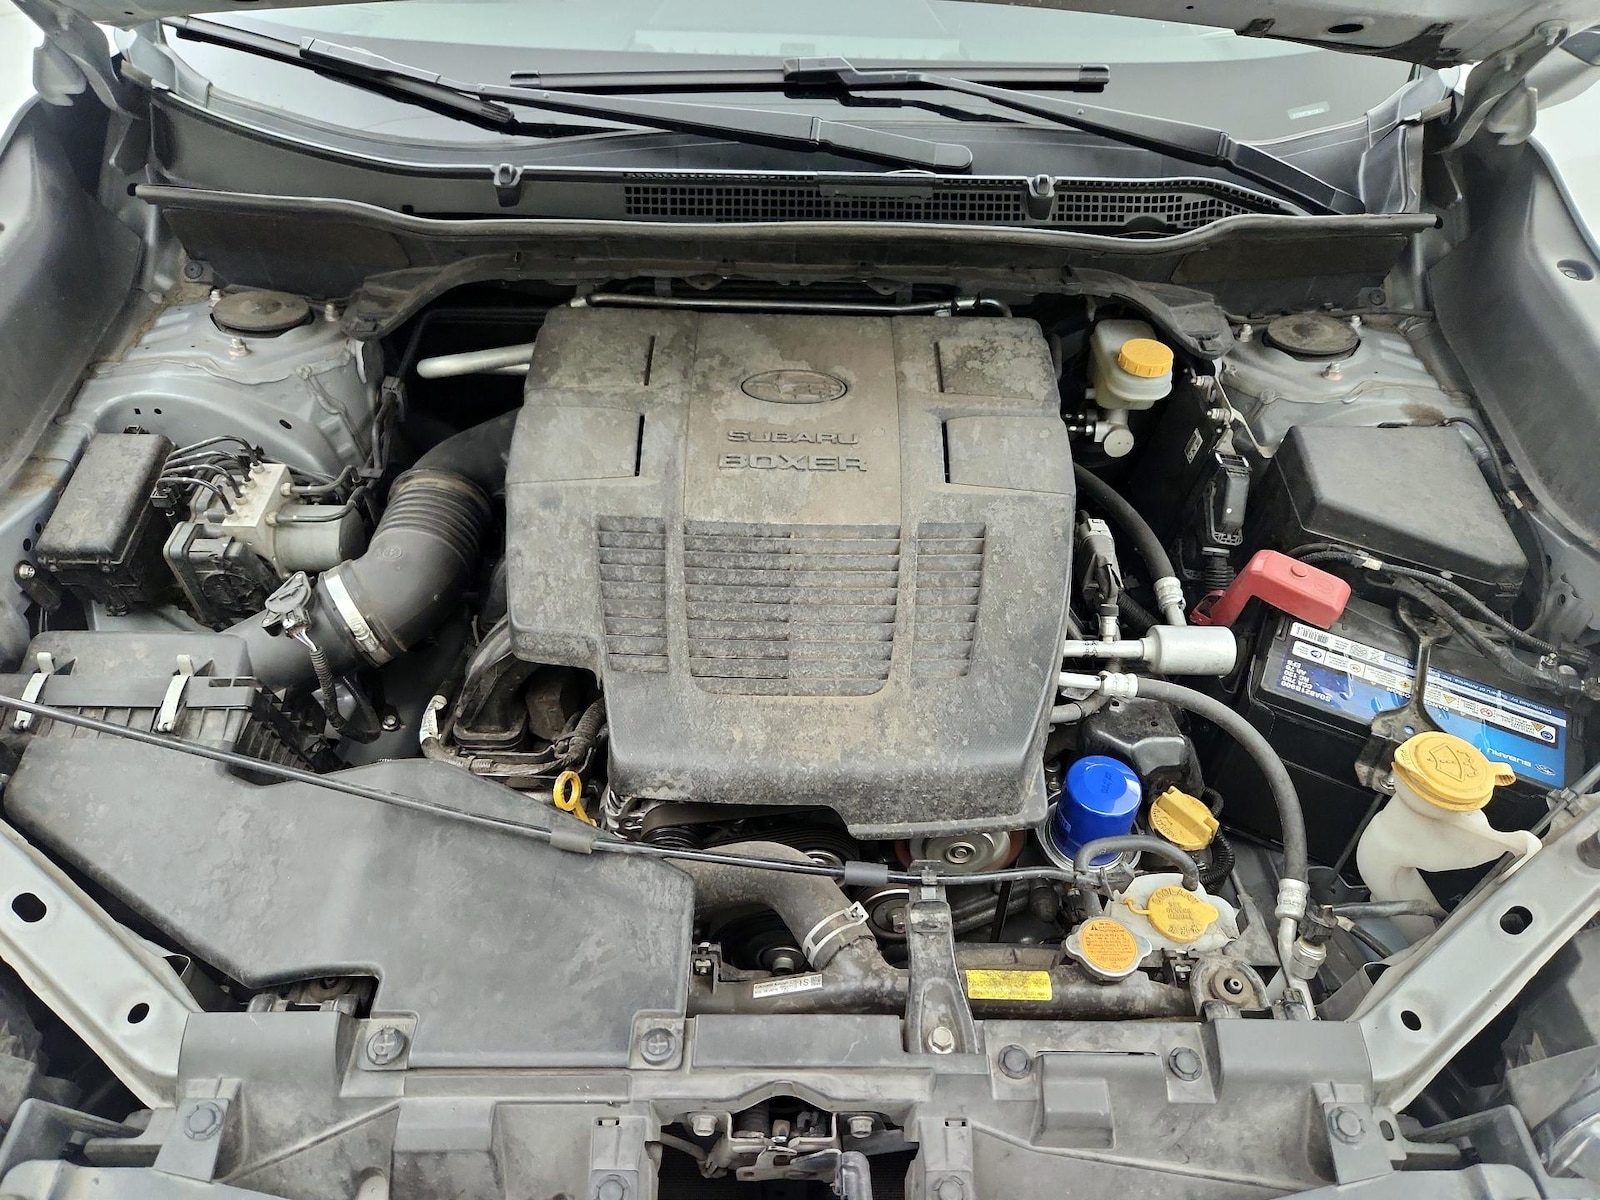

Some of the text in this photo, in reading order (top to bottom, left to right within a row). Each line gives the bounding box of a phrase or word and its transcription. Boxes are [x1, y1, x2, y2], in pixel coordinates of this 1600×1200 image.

[728, 430, 859, 444] SUBARU
[718, 453, 867, 472] BOXER
[1298, 680, 1313, 690] CCA
[1386, 687, 1411, 699] OISON
[1519, 700, 1552, 715] Distributed
[1486, 747, 1532, 767] SUBARU
